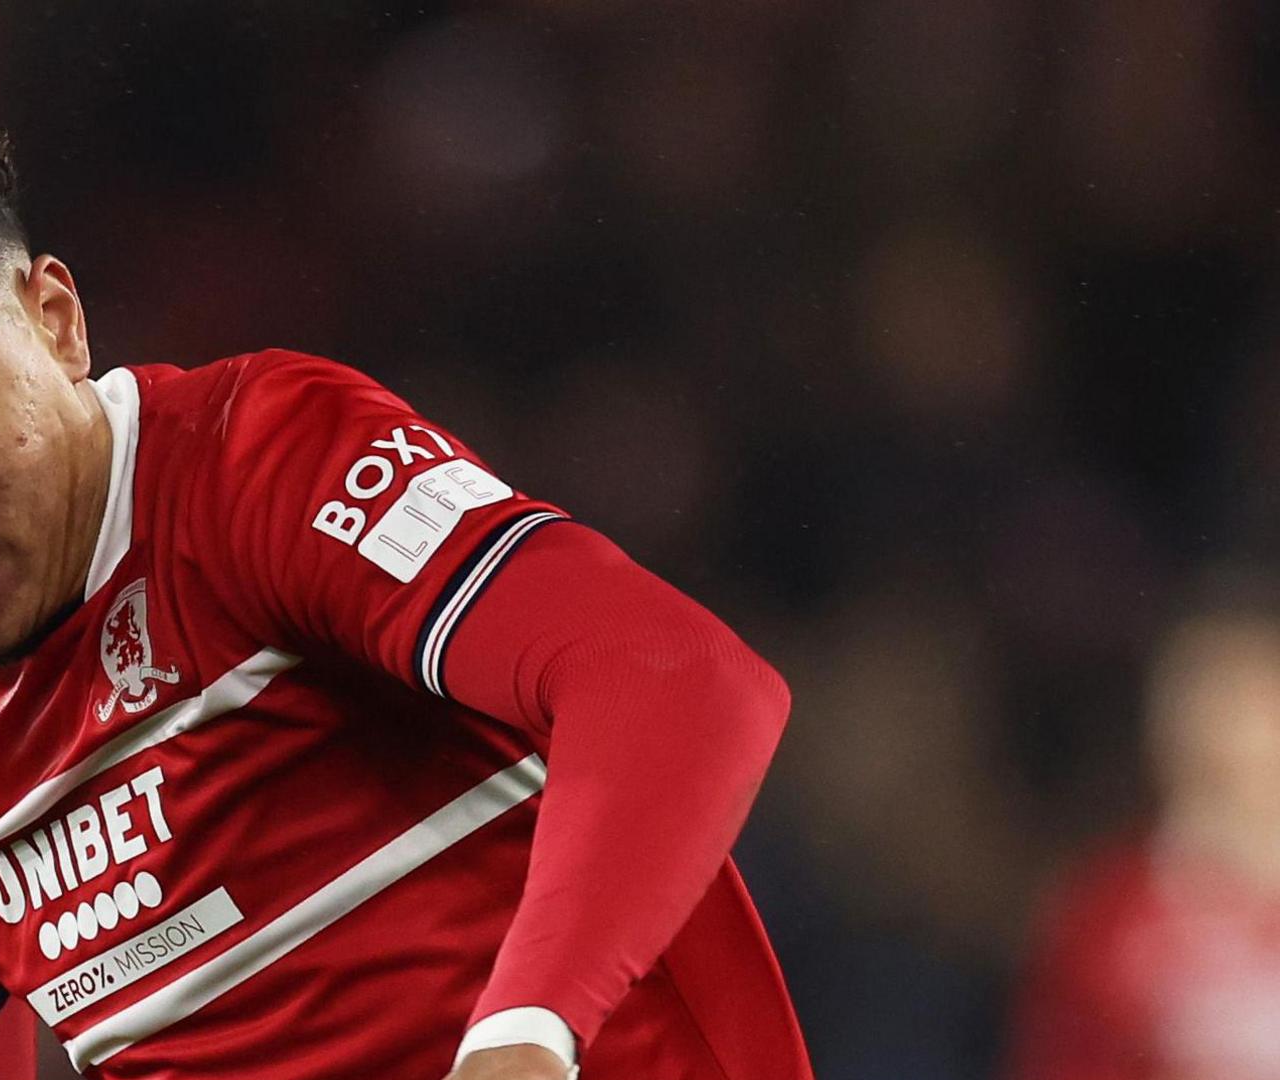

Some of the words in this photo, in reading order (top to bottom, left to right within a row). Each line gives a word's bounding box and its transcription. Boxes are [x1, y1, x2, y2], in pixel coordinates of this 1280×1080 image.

[377, 465, 494, 562] LIFE
[48, 963, 114, 1013] ZERO%
[113, 914, 206, 977] MISSION
